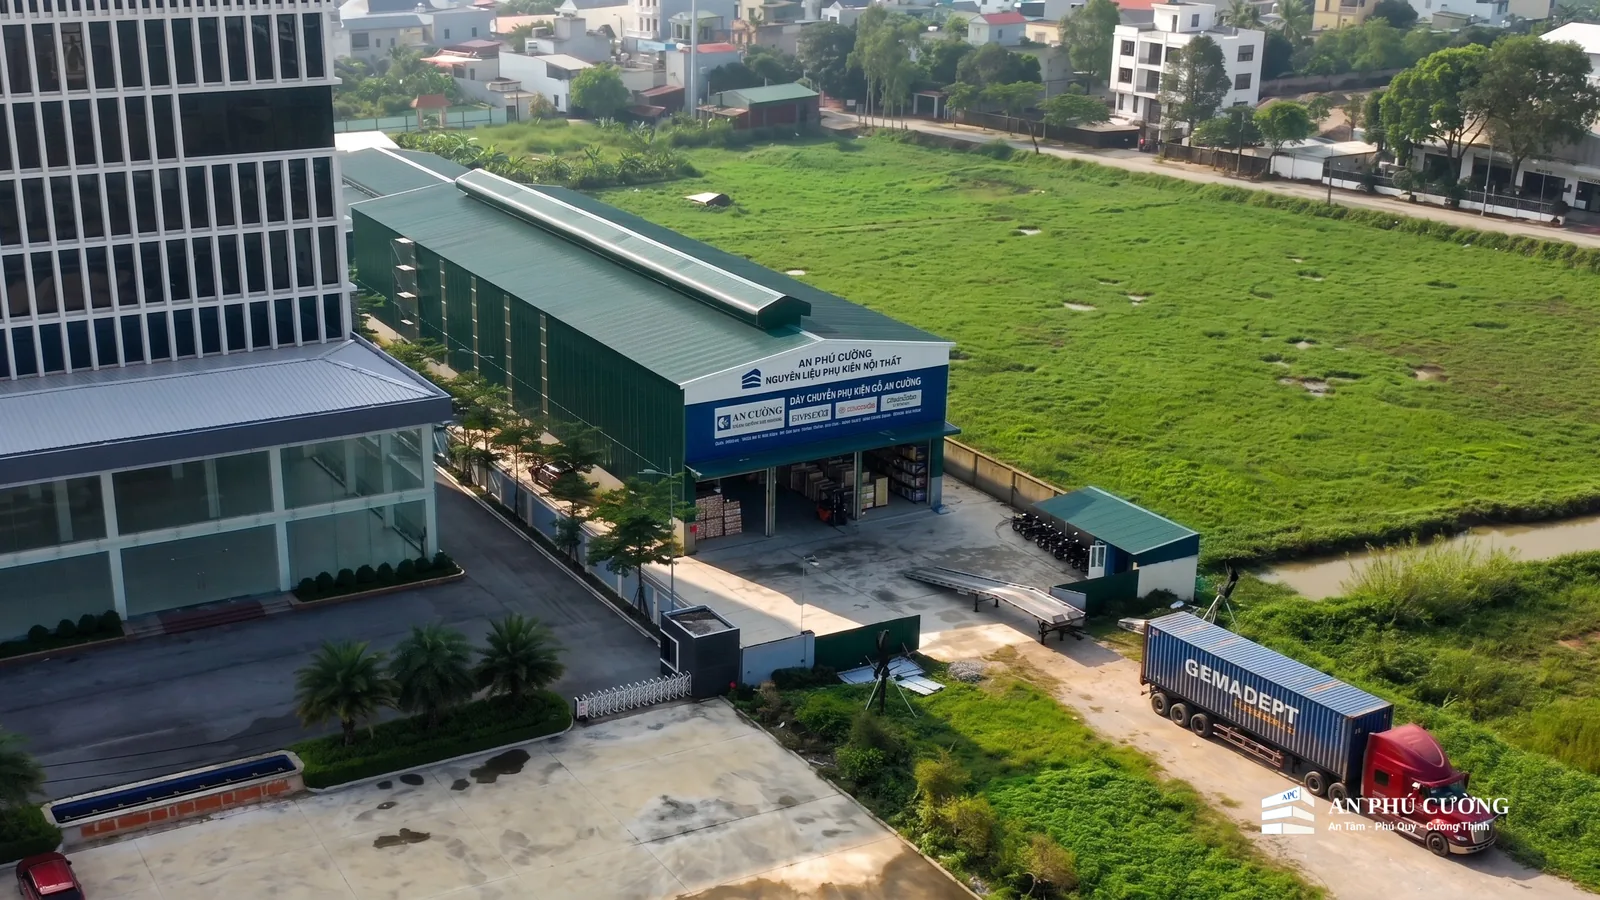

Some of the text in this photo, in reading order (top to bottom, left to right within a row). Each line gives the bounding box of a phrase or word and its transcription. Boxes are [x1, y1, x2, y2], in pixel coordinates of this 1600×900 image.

[798, 348, 872, 369] AN PHÚ CƯỜNG
[765, 371, 801, 385] NGUYÊN
[802, 368, 821, 380] LIỆU
[822, 366, 841, 377] PHỤ
[863, 360, 878, 372] NỘI
[879, 355, 902, 367] THẤT
[837, 388, 852, 399] PHỤ
[883, 382, 895, 391] AN
[732, 412, 747, 422] AN
[748, 406, 783, 420] CƯỜNG
[1185, 658, 1299, 724] GEMADEPT
